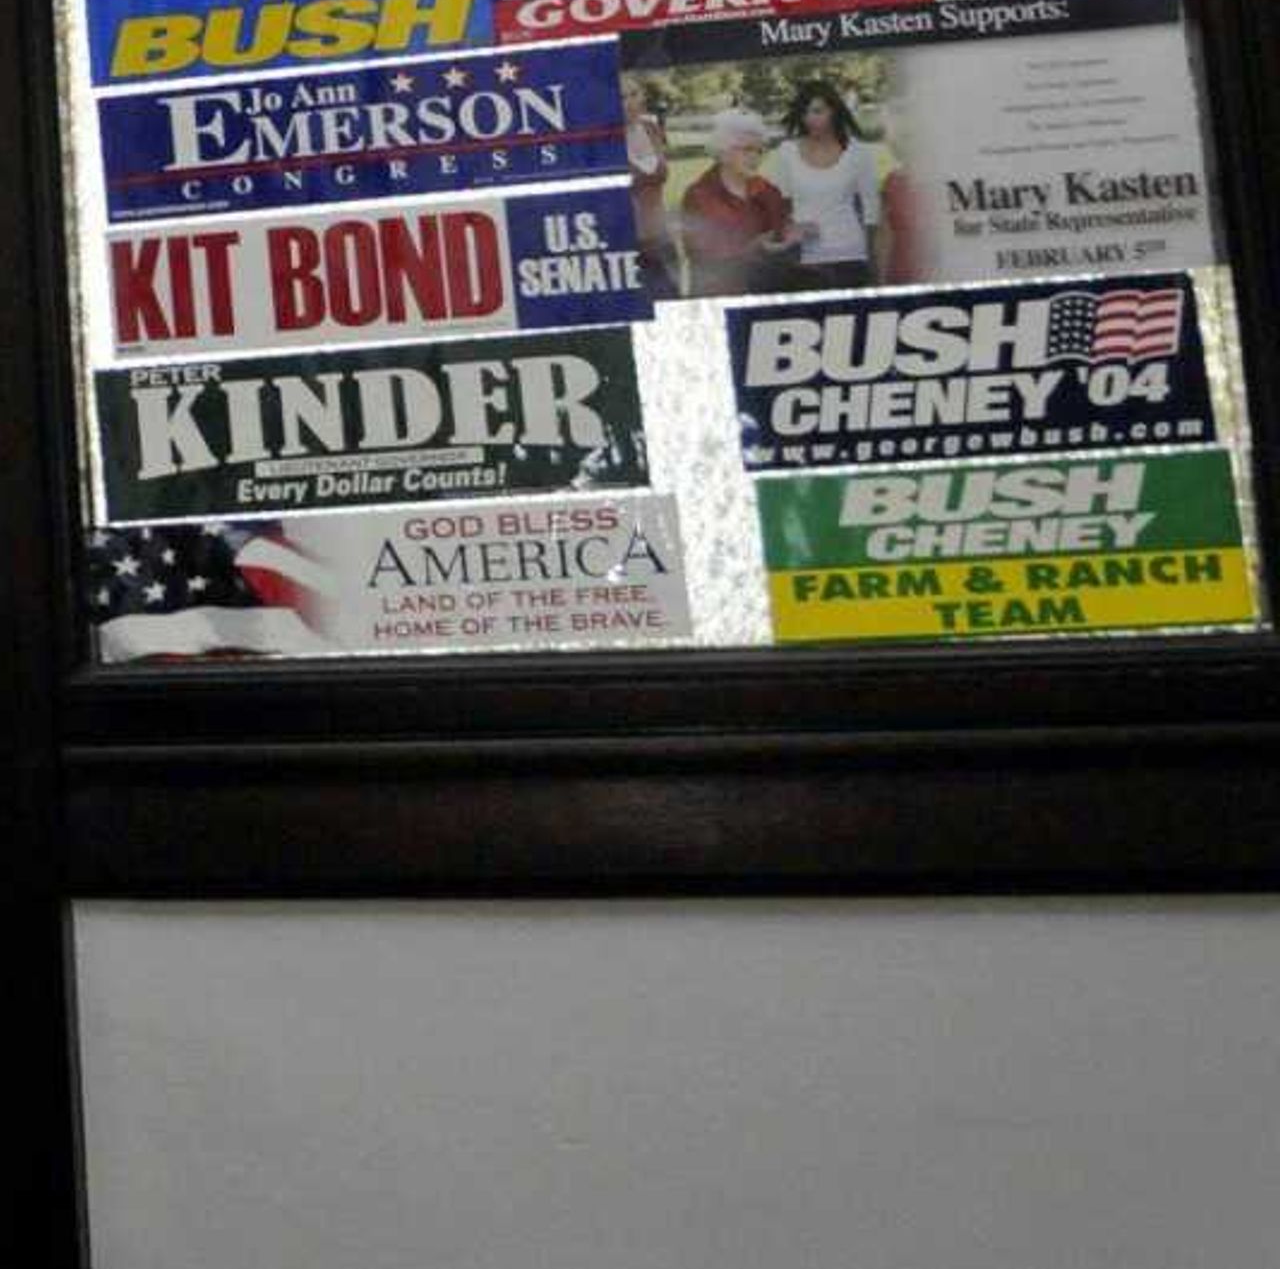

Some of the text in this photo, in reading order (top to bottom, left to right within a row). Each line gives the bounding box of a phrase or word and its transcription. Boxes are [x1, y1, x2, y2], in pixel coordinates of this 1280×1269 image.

[760, 14, 835, 47] Mary
[840, 9, 933, 37] Kasten
[245, 81, 357, 115] Jo Ann
[159, 85, 565, 170] EMERSON
[948, 170, 1197, 212] Mary Kasten
[544, 212, 607, 251] U.S.
[110, 210, 503, 342] KIT BOND
[519, 252, 640, 297] SENATE
[745, 297, 1049, 387] BUSH
[129, 364, 222, 386] PETER
[130, 355, 610, 481] KINDER
[771, 363, 1171, 435] CHENEY '04
[238, 462, 506, 504] Every Dollar Counts!
[840, 462, 1145, 528] BUSH
[405, 508, 619, 541] GOD BLESS
[867, 512, 1155, 563] CHENEY
[369, 529, 666, 587] AMERICA
[794, 555, 1221, 602] FARM & RANCH
[383, 589, 565, 615] LAND OF THE
[933, 597, 1085, 629] TEAM
[374, 614, 561, 640] HOME THE
